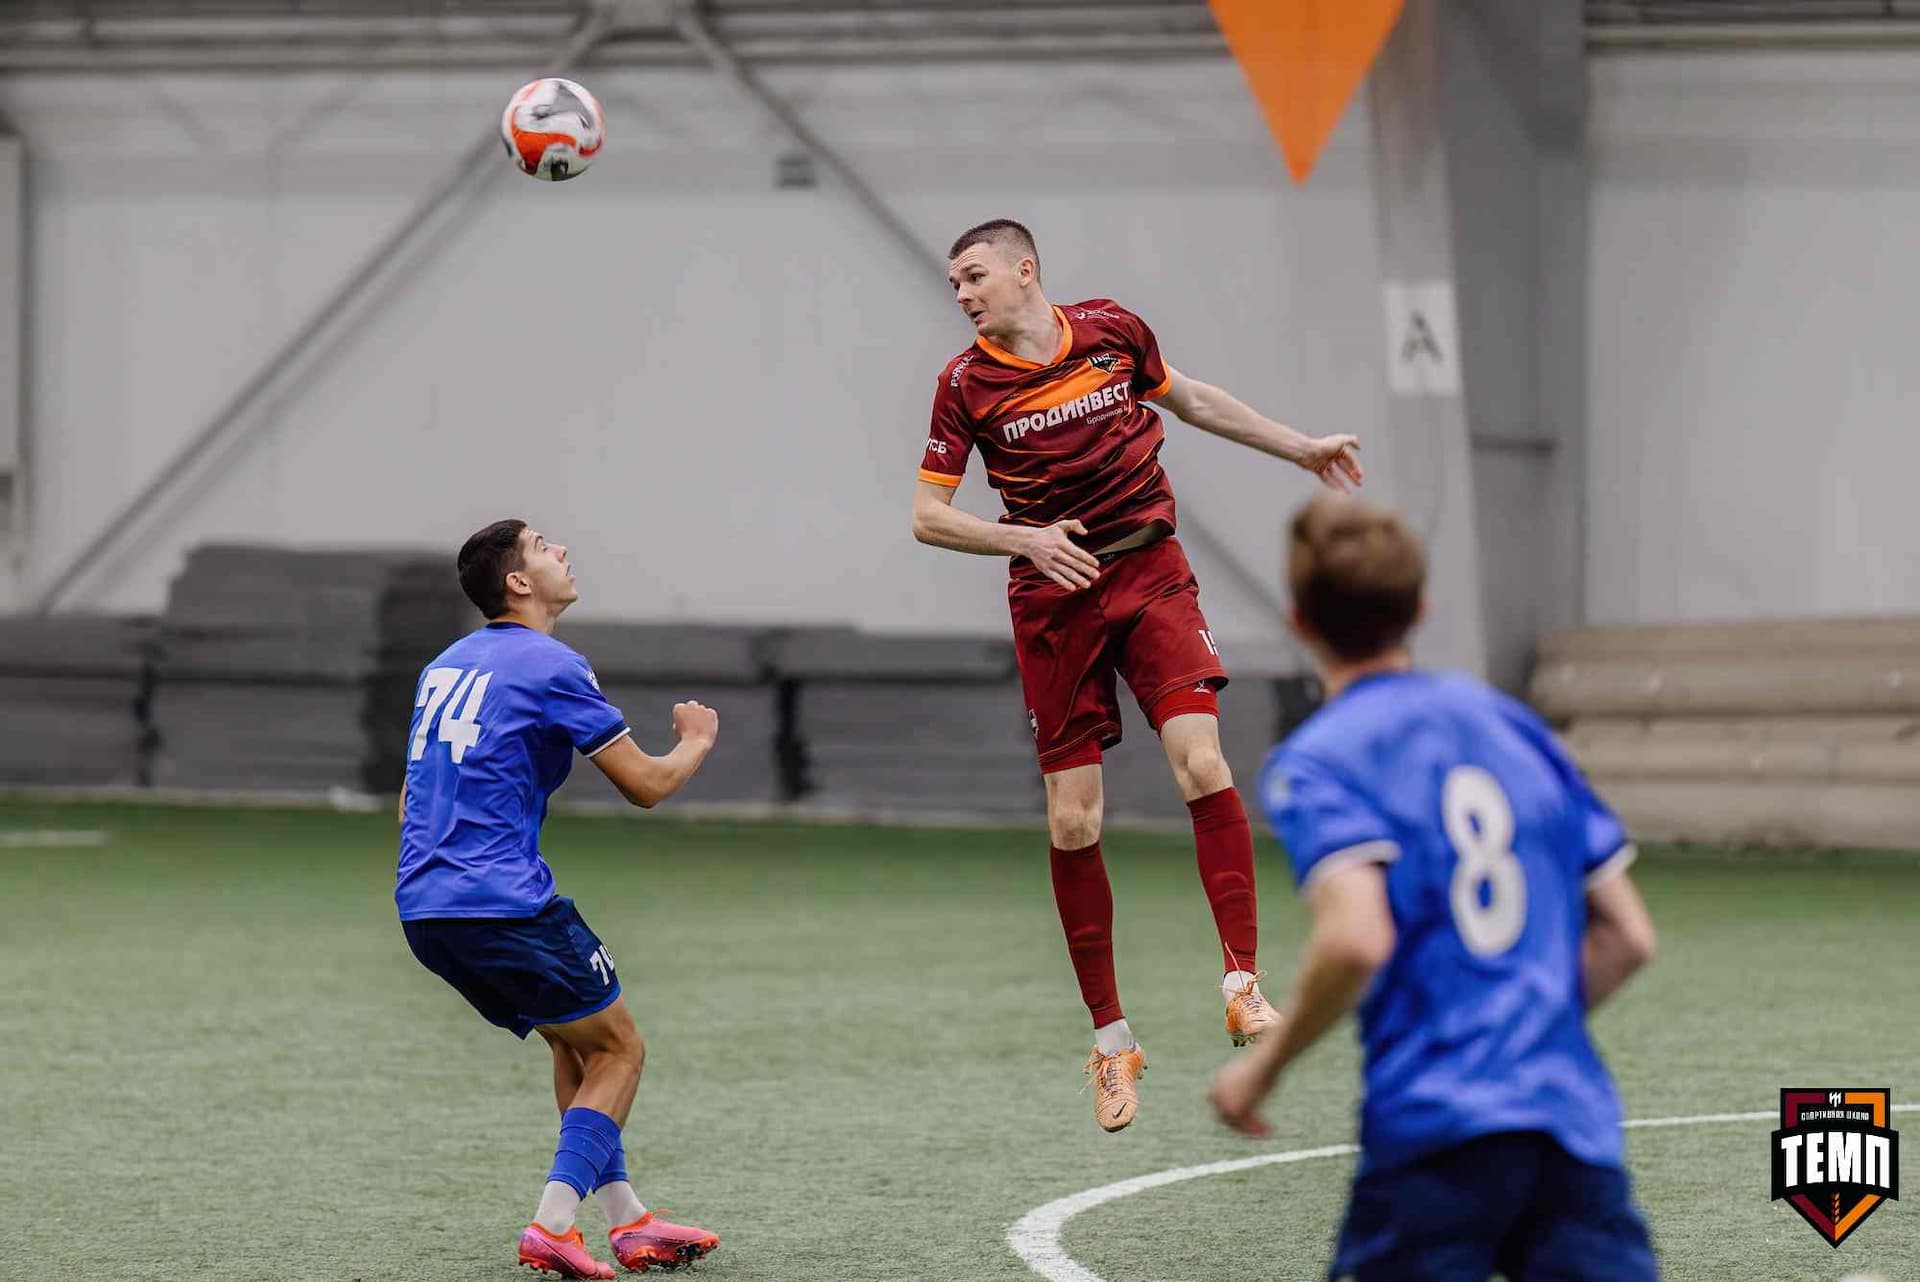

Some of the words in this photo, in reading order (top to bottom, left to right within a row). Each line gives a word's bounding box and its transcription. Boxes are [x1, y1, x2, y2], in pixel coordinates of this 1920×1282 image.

[1003, 382, 1130, 443] ПРОДИНВЕСТ
[410, 667, 493, 764] 74
[1441, 763, 1529, 959] 8
